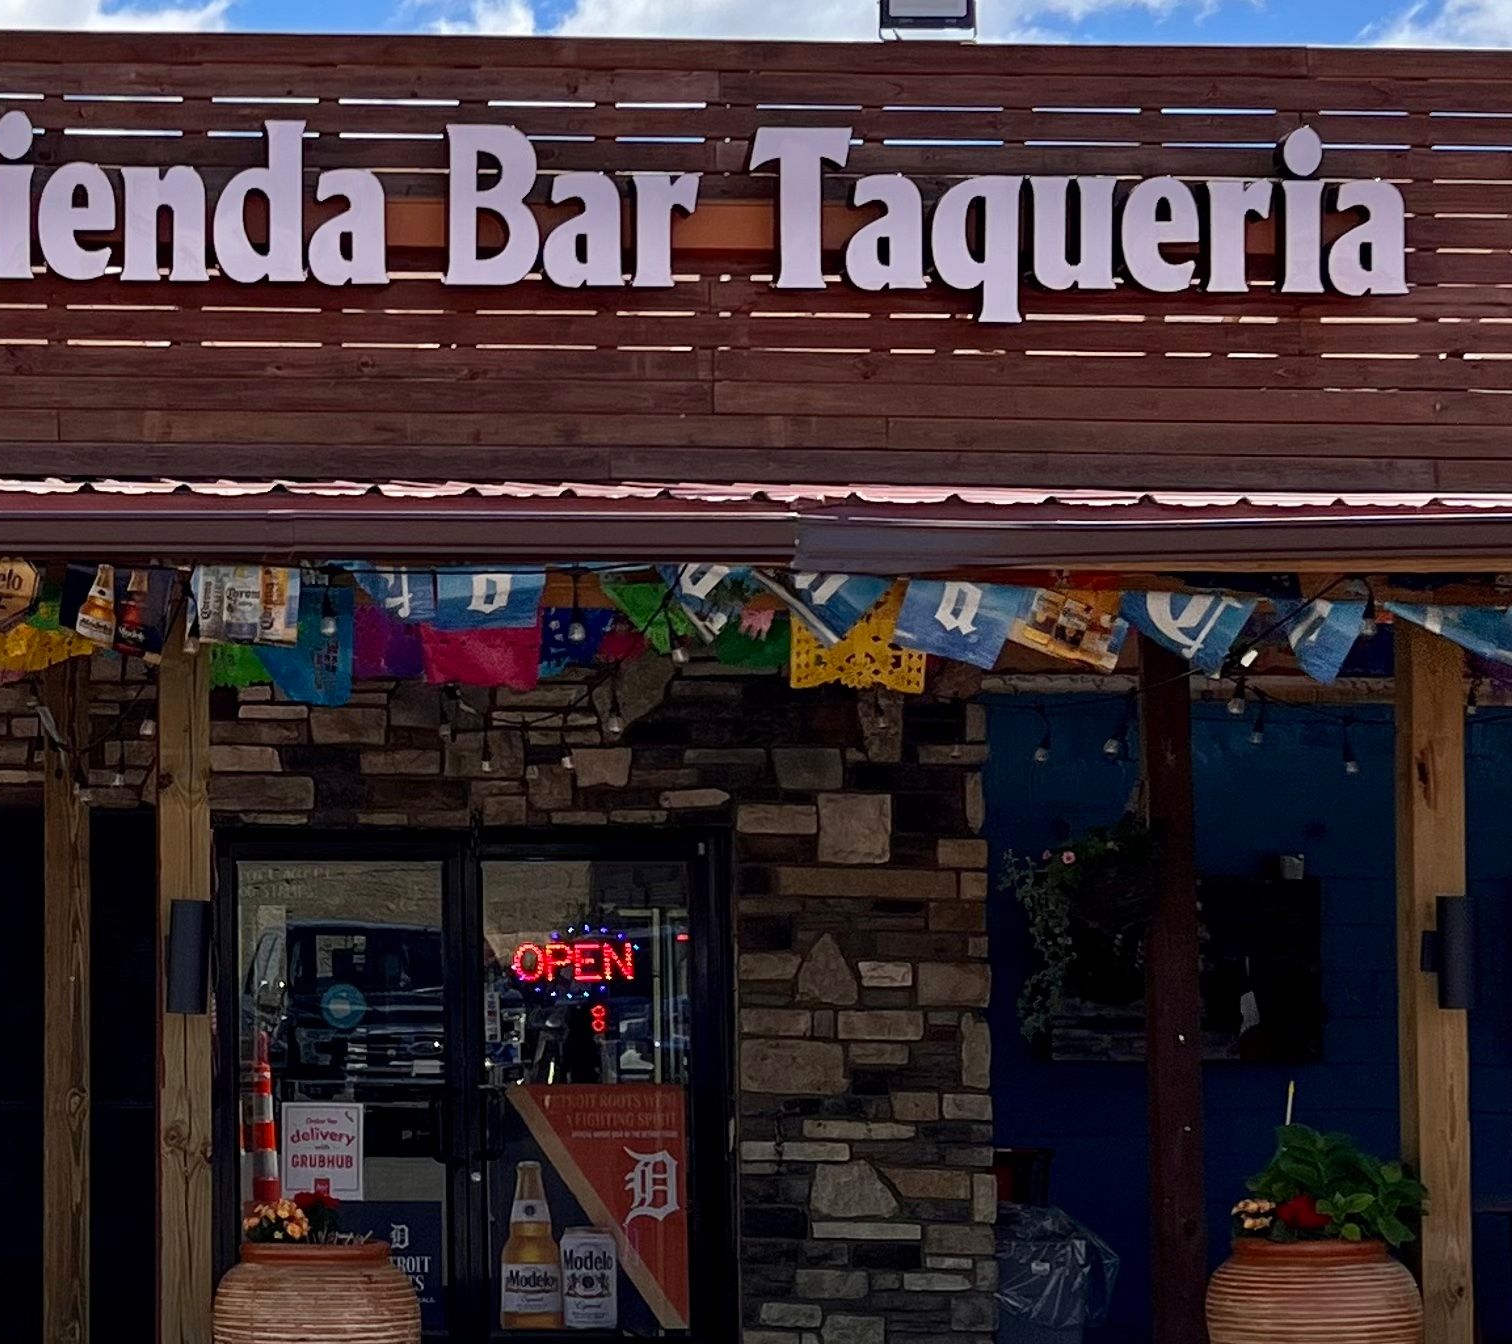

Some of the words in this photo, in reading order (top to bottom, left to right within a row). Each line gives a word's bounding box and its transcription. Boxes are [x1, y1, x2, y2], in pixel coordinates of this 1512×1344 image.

[443, 123, 700, 289] Bar
[750, 125, 1409, 323] Taqueria
[511, 940, 635, 983] OPEN
[290, 1127, 355, 1146] delivery
[291, 1154, 354, 1168] GRUBHUB
[563, 1249, 613, 1271] Modelo
[509, 1269, 553, 1288] Modelo
